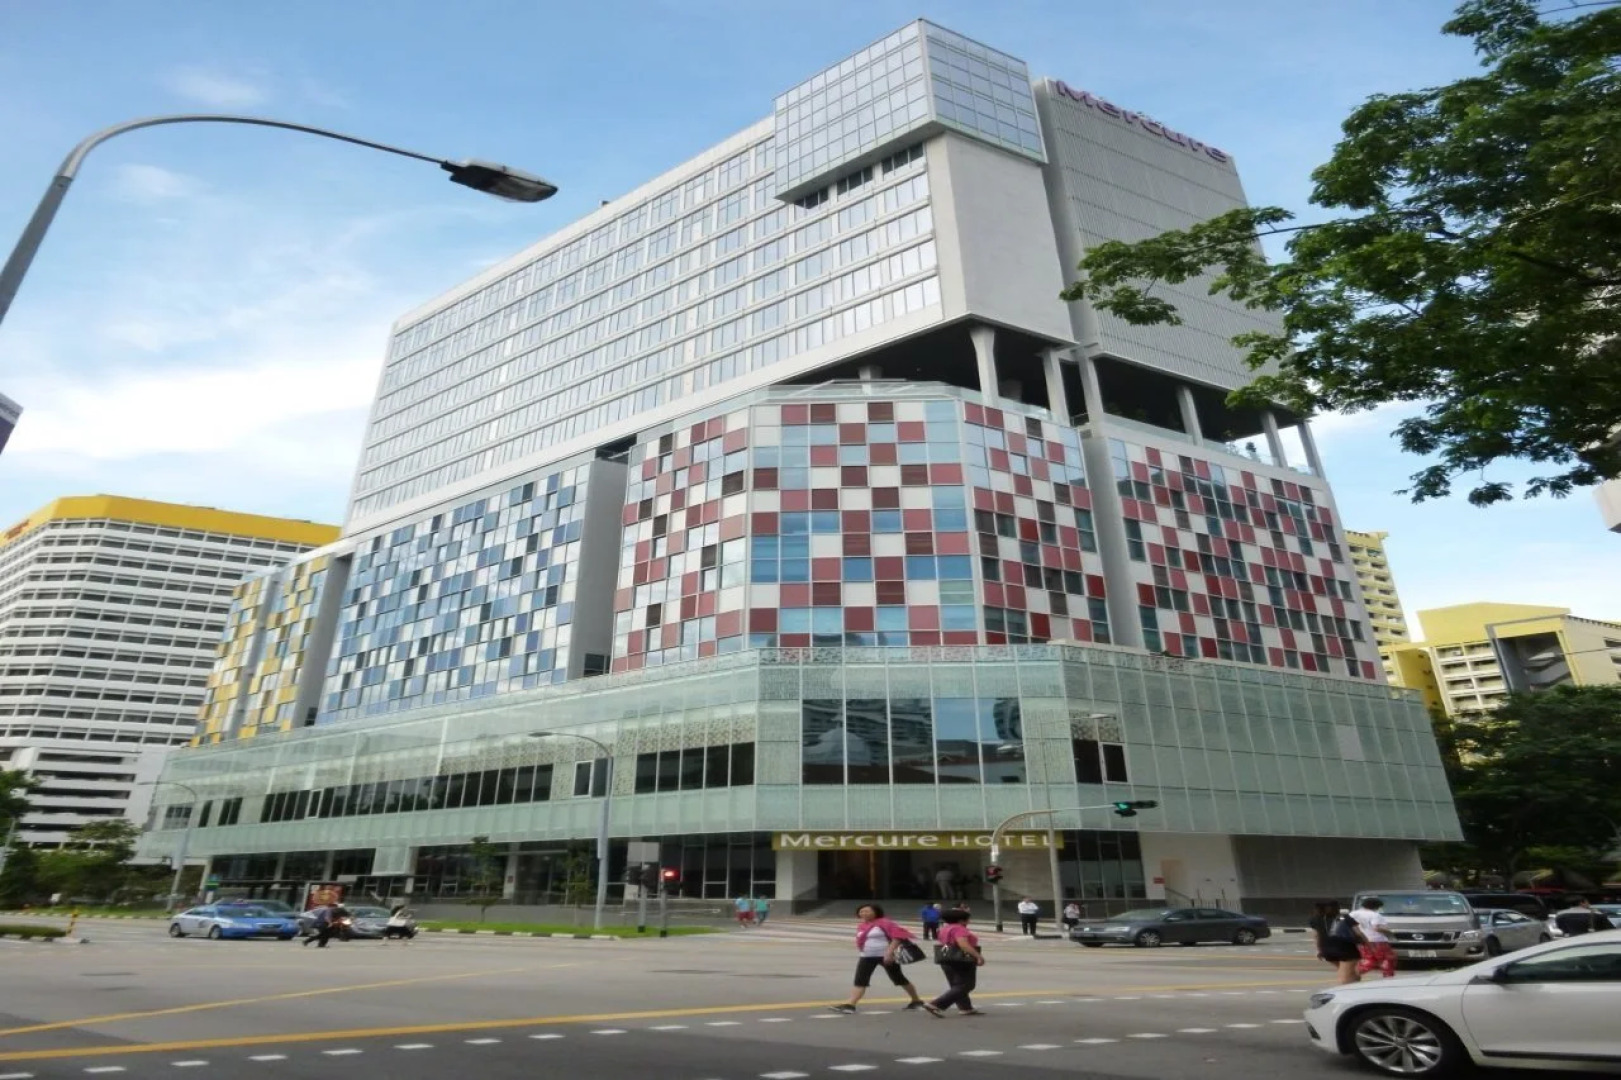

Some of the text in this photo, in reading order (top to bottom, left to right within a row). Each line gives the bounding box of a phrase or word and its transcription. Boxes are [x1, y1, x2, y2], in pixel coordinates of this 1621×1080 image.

[1056, 80, 1227, 163] Mercure
[780, 833, 1052, 847] Mercure HOTEL
